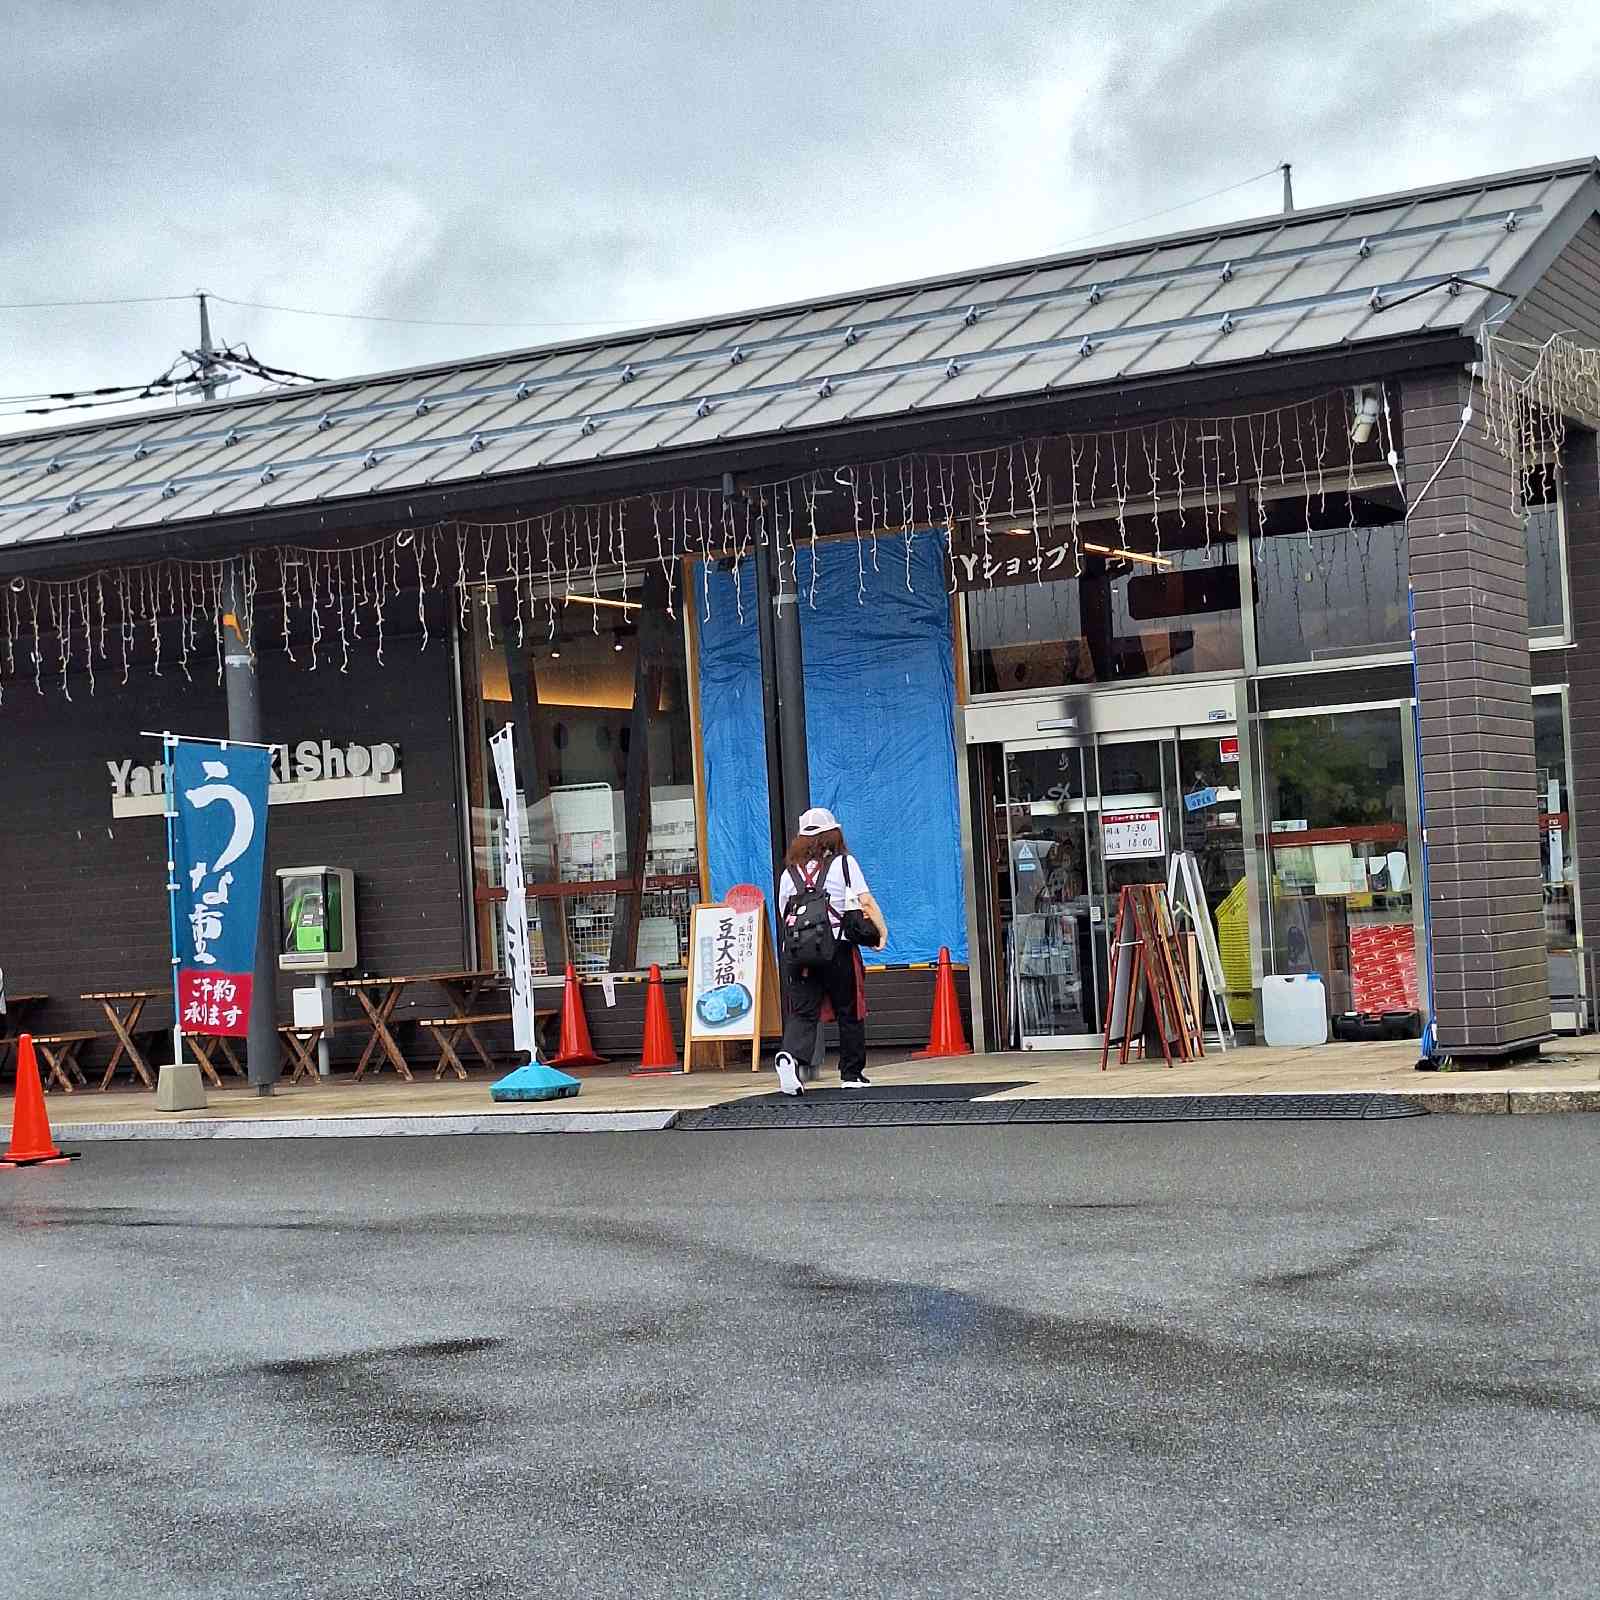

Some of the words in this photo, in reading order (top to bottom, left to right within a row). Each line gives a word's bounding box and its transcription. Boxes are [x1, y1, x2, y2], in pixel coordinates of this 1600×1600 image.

[960, 542, 1069, 581] Yショップ
[184, 761, 255, 965] うな重
[714, 917, 736, 985] 豆大福
[192, 978, 236, 1002] ご予約
[184, 1001, 243, 1028] 承ります
